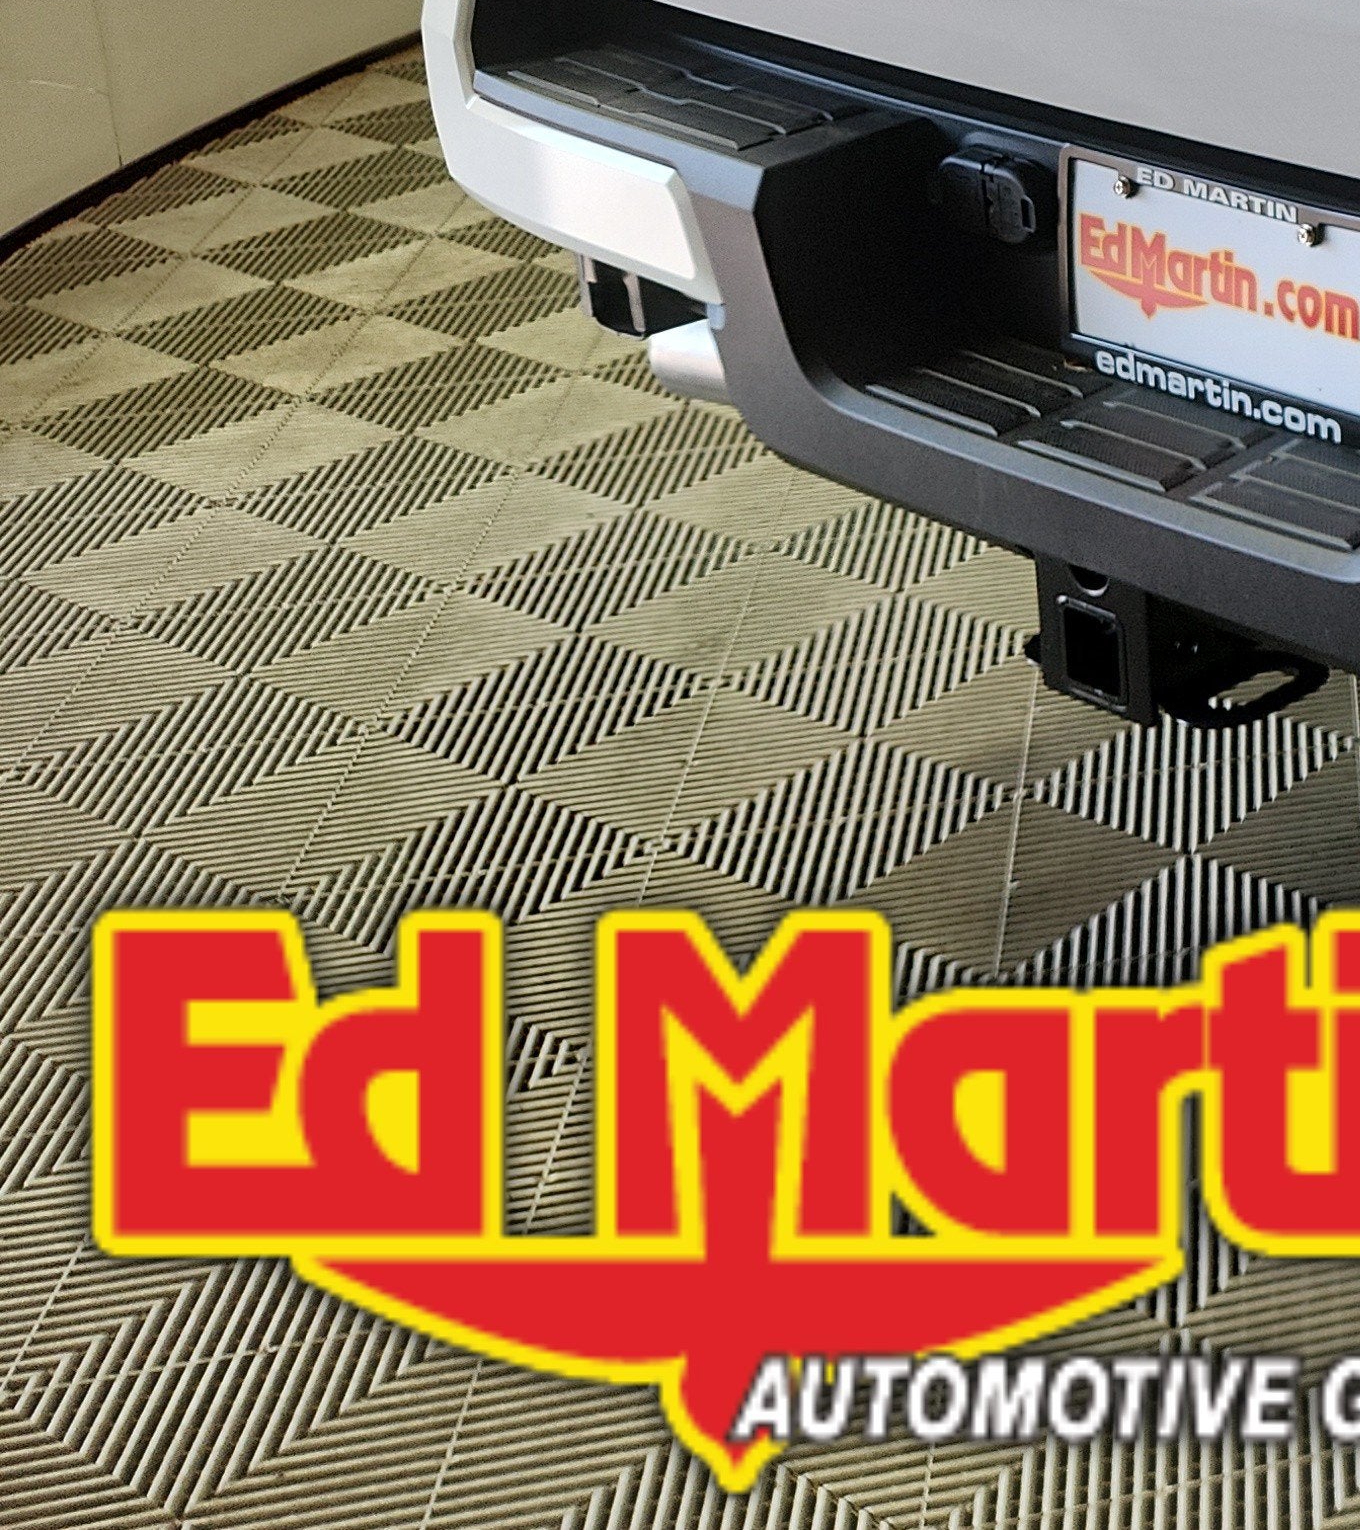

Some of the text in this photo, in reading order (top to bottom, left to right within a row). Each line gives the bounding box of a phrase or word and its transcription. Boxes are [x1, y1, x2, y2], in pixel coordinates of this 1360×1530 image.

[1134, 167, 1299, 223] ED MARTIN
[1097, 349, 1342, 443] edmartin.com
